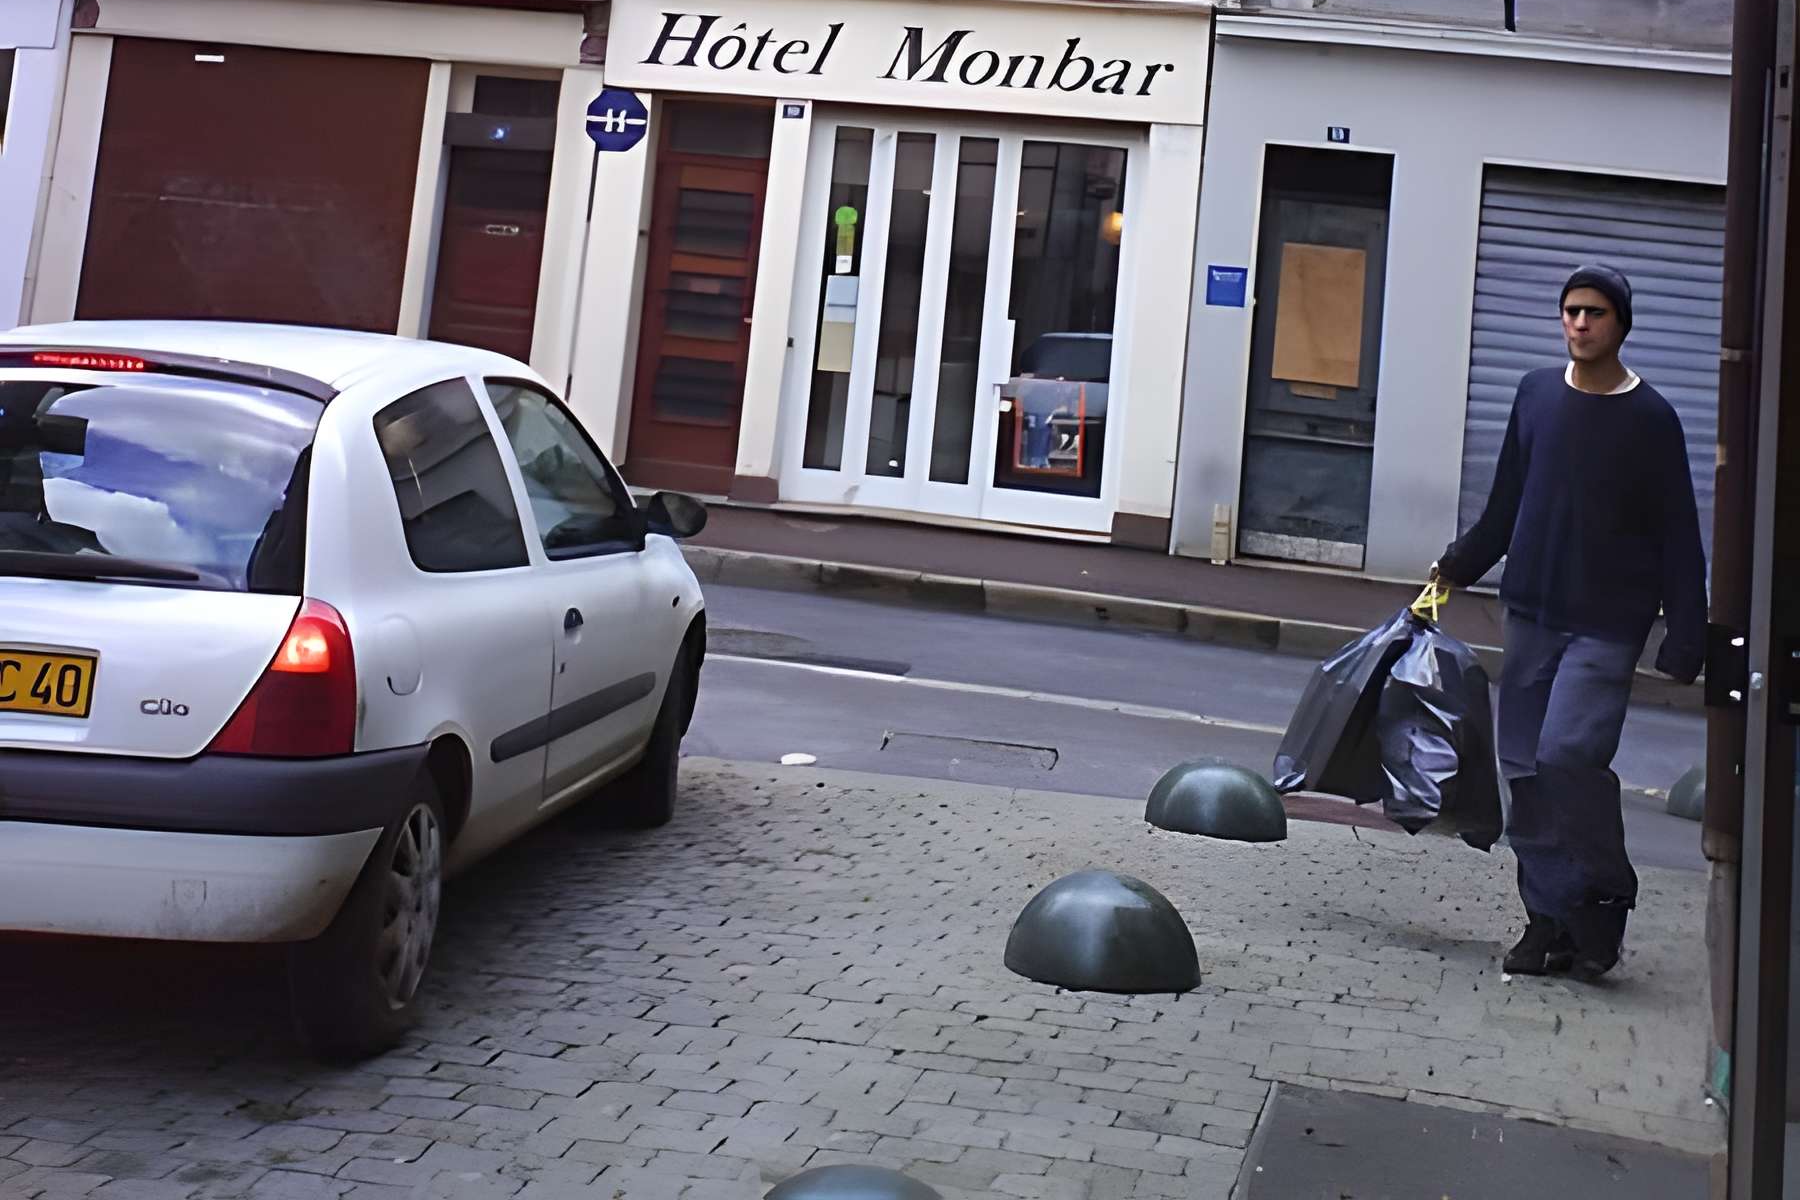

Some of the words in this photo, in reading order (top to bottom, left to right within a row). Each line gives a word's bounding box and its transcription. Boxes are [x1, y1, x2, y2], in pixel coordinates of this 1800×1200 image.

[638, 12, 845, 75] Hôtel
[875, 26, 1175, 96] Monbar
[30, 662, 82, 708] 40
